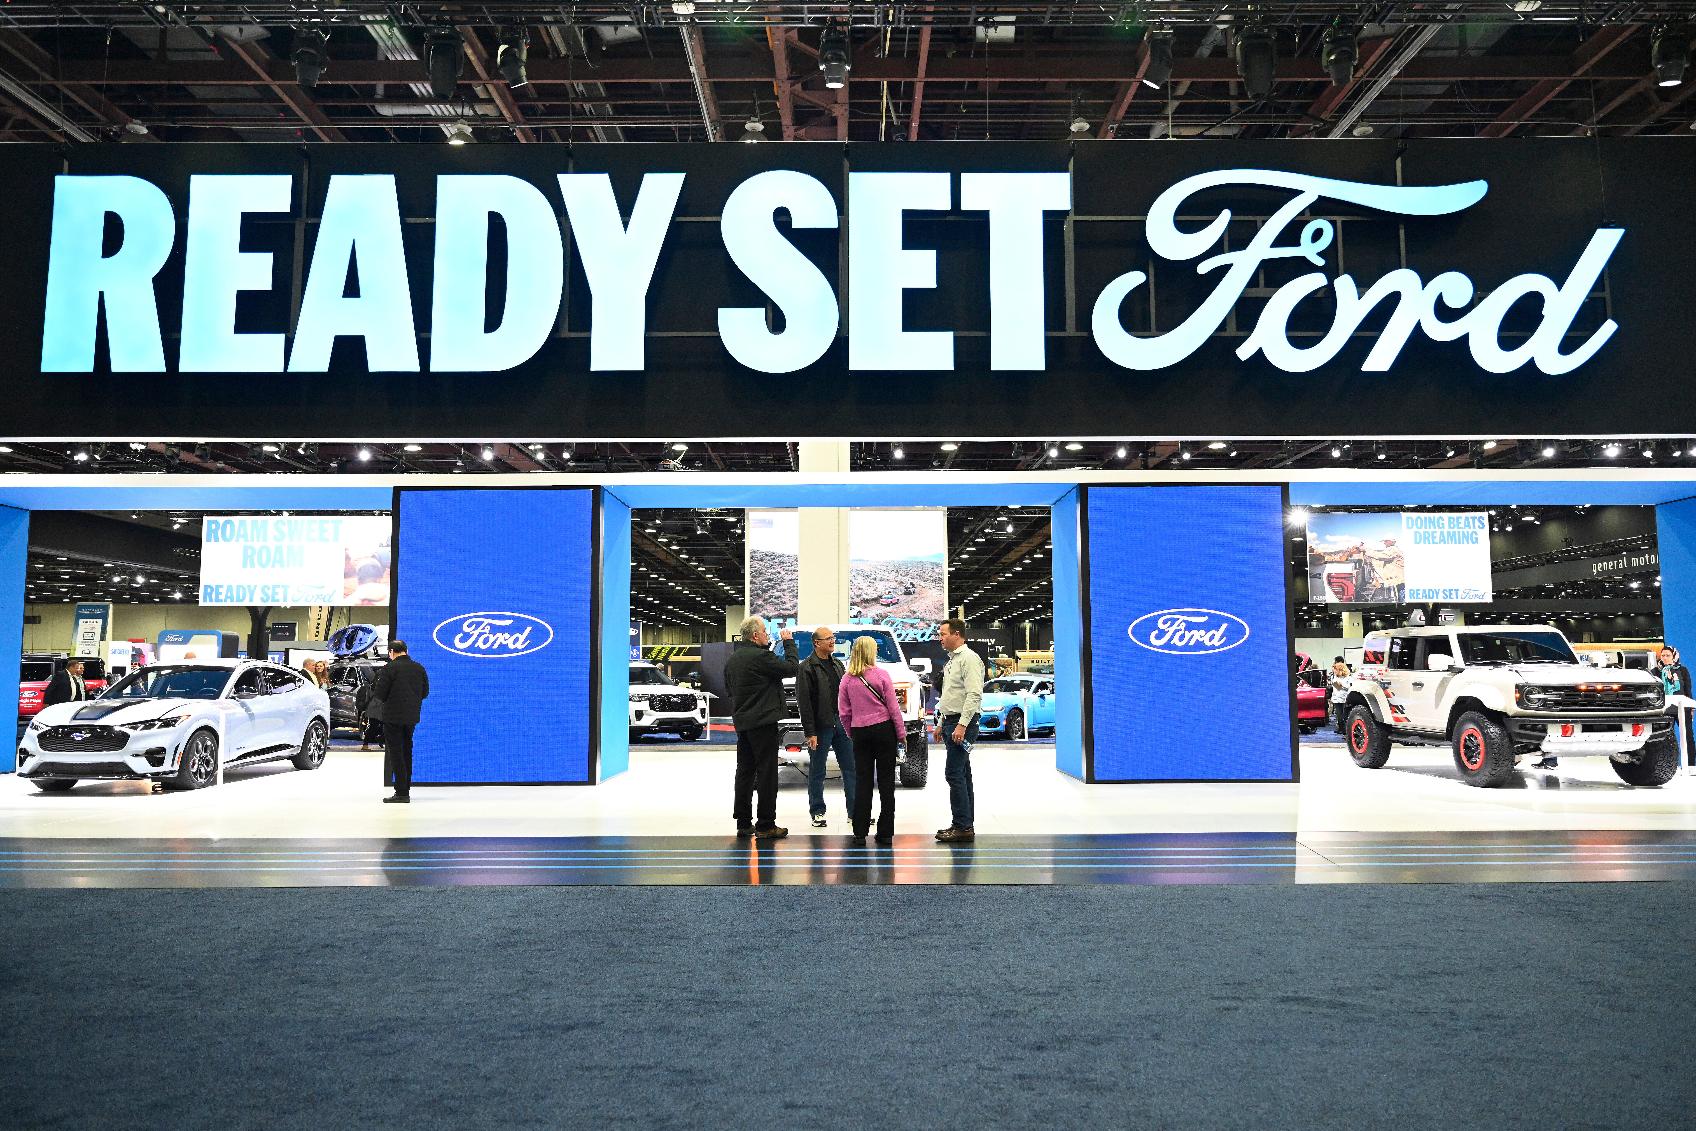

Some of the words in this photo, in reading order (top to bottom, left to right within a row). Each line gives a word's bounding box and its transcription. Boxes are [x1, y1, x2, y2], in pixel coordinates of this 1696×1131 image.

[41, 173, 686, 373] READY
[717, 170, 1072, 374] SET
[1091, 168, 1625, 376] Ford
[205, 519, 269, 543] ROAM
[273, 519, 343, 543] SWEET
[1406, 516, 1445, 530] DOING
[1447, 515, 1486, 530] BEATS
[1413, 530, 1479, 545] DREAMING
[241, 545, 304, 569] ROAM
[1592, 556, 1628, 576] general
[202, 584, 257, 603] READY
[260, 584, 290, 603] SET
[291, 584, 337, 604] Ford
[1408, 588, 1440, 600] READY
[1442, 588, 1460, 600] SET
[1461, 588, 1488, 600] Ford
[164, 634, 184, 643] Ford
[454, 617, 533, 649] Ford
[1149, 614, 1229, 647] Ford
